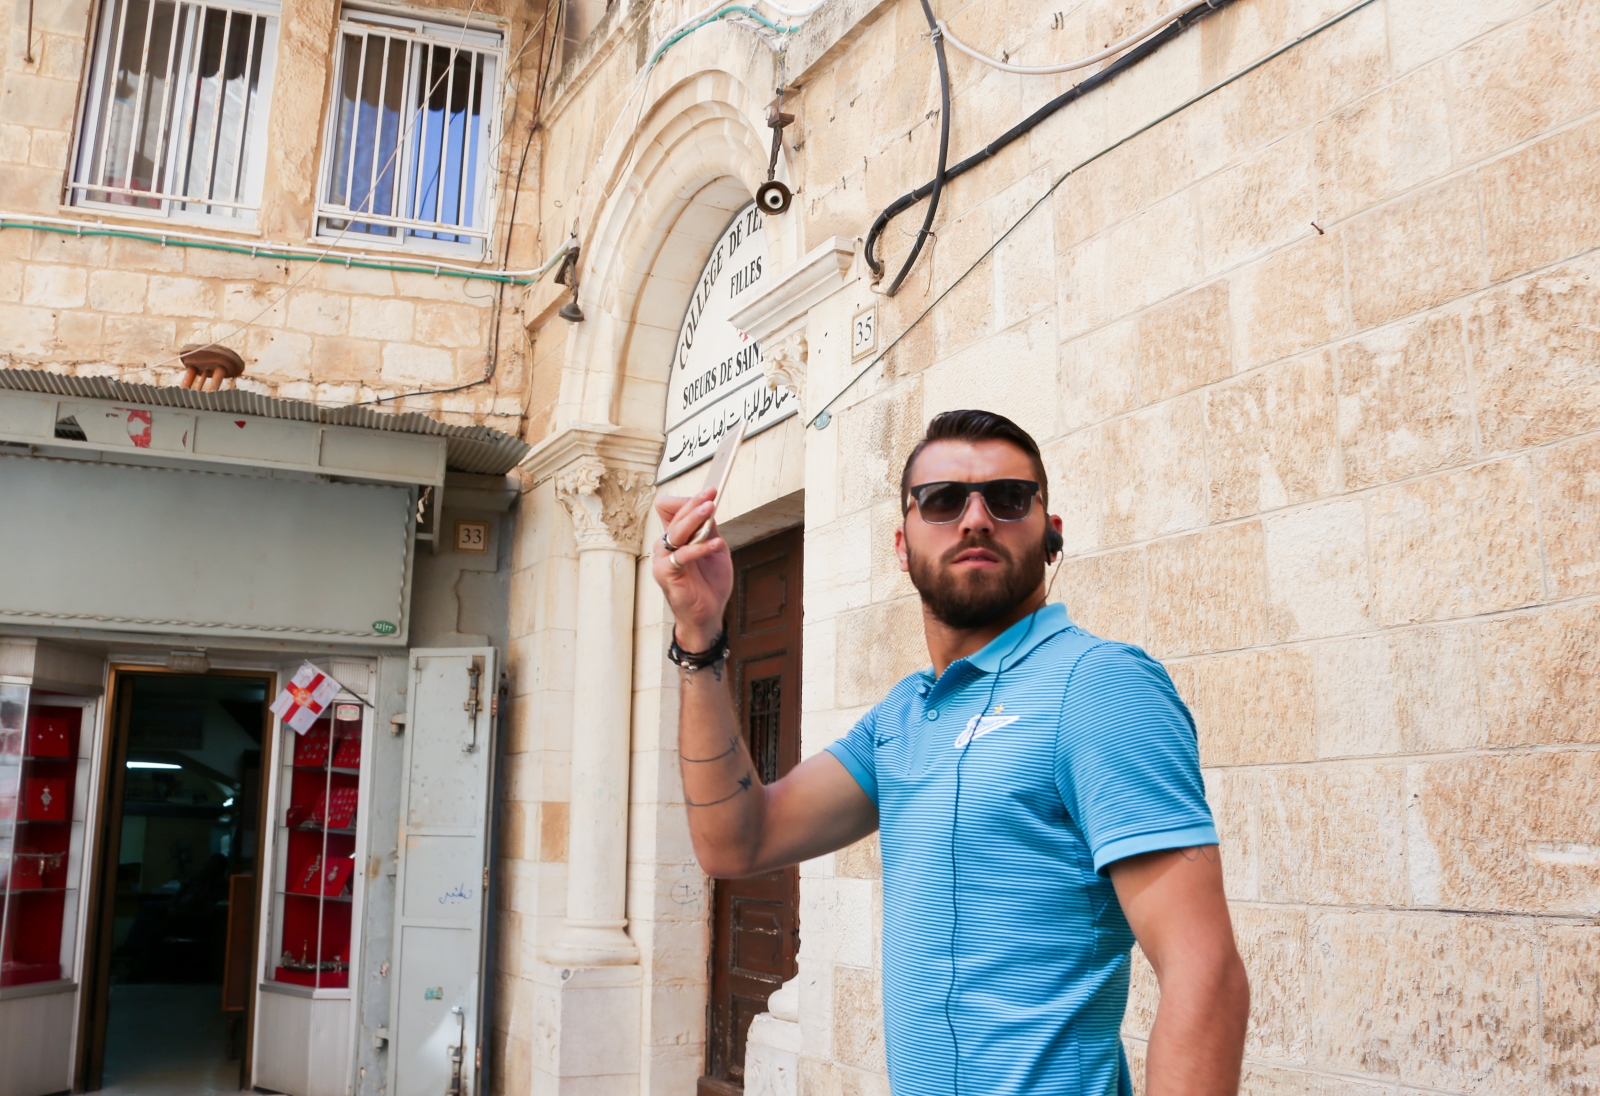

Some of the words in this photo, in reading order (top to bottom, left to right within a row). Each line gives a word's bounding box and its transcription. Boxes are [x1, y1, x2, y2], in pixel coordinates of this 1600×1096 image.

[680, 244, 723, 370] COLLEGE
[729, 220, 742, 258] DE
[730, 256, 761, 299] FILLES
[855, 316, 872, 346] 35
[683, 367, 717, 410] SOEURS
[720, 357, 733, 386] DE
[735, 342, 763, 377] SAIN
[462, 528, 482, 544] 33
